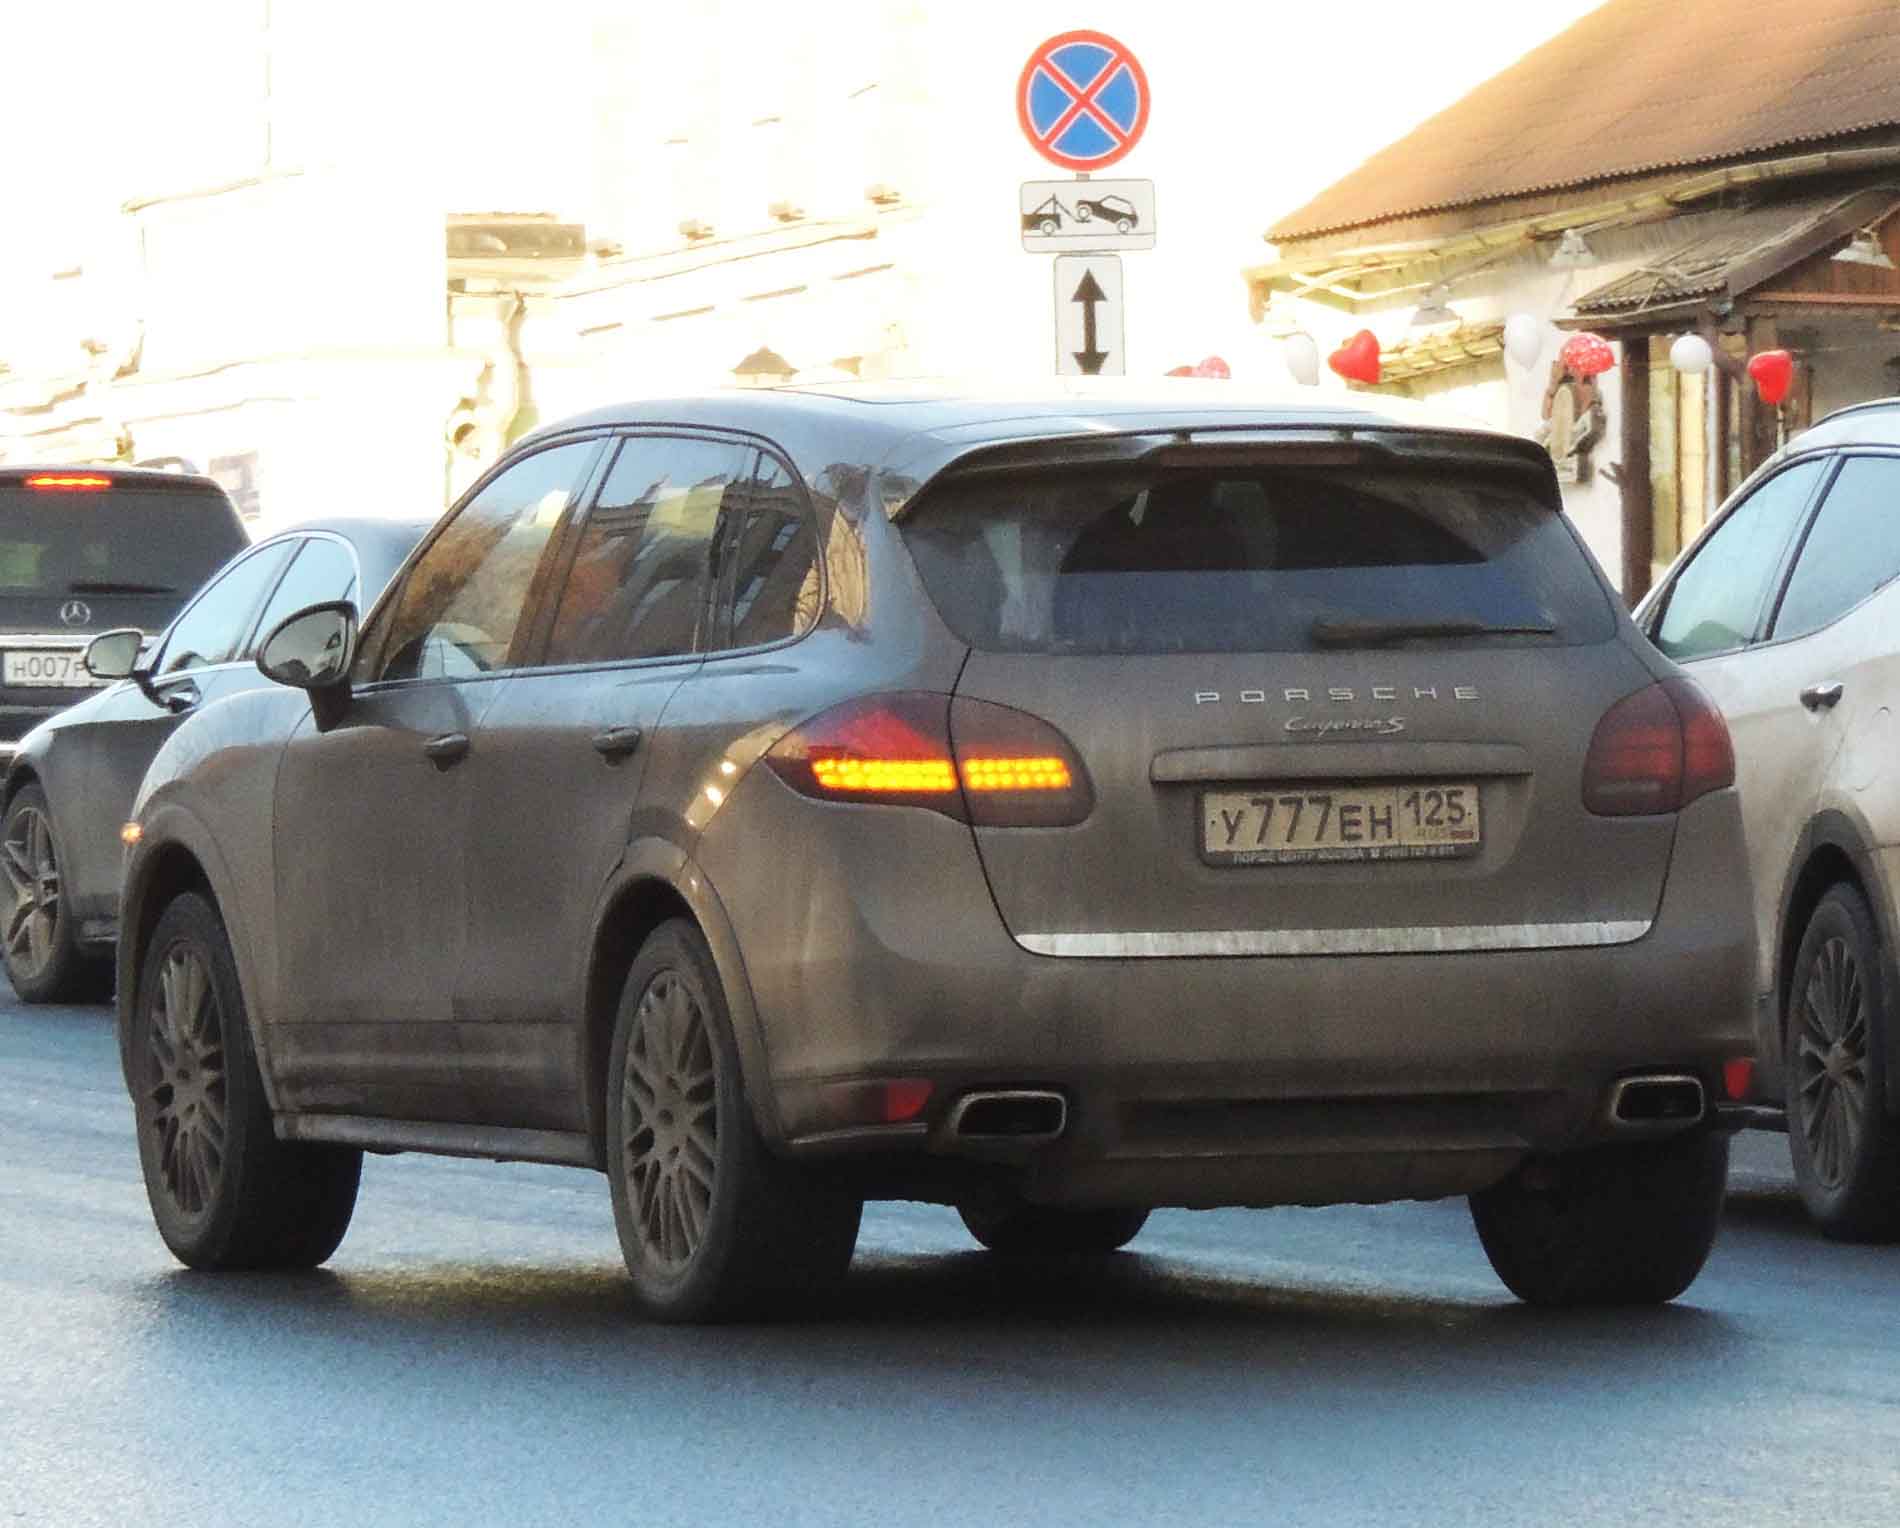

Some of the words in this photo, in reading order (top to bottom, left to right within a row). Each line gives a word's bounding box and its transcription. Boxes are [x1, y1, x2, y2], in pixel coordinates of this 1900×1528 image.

[1195, 686, 1480, 704] PORSCHE
[1221, 795, 1393, 844] У777ЕН
[1404, 789, 1465, 826] 125
